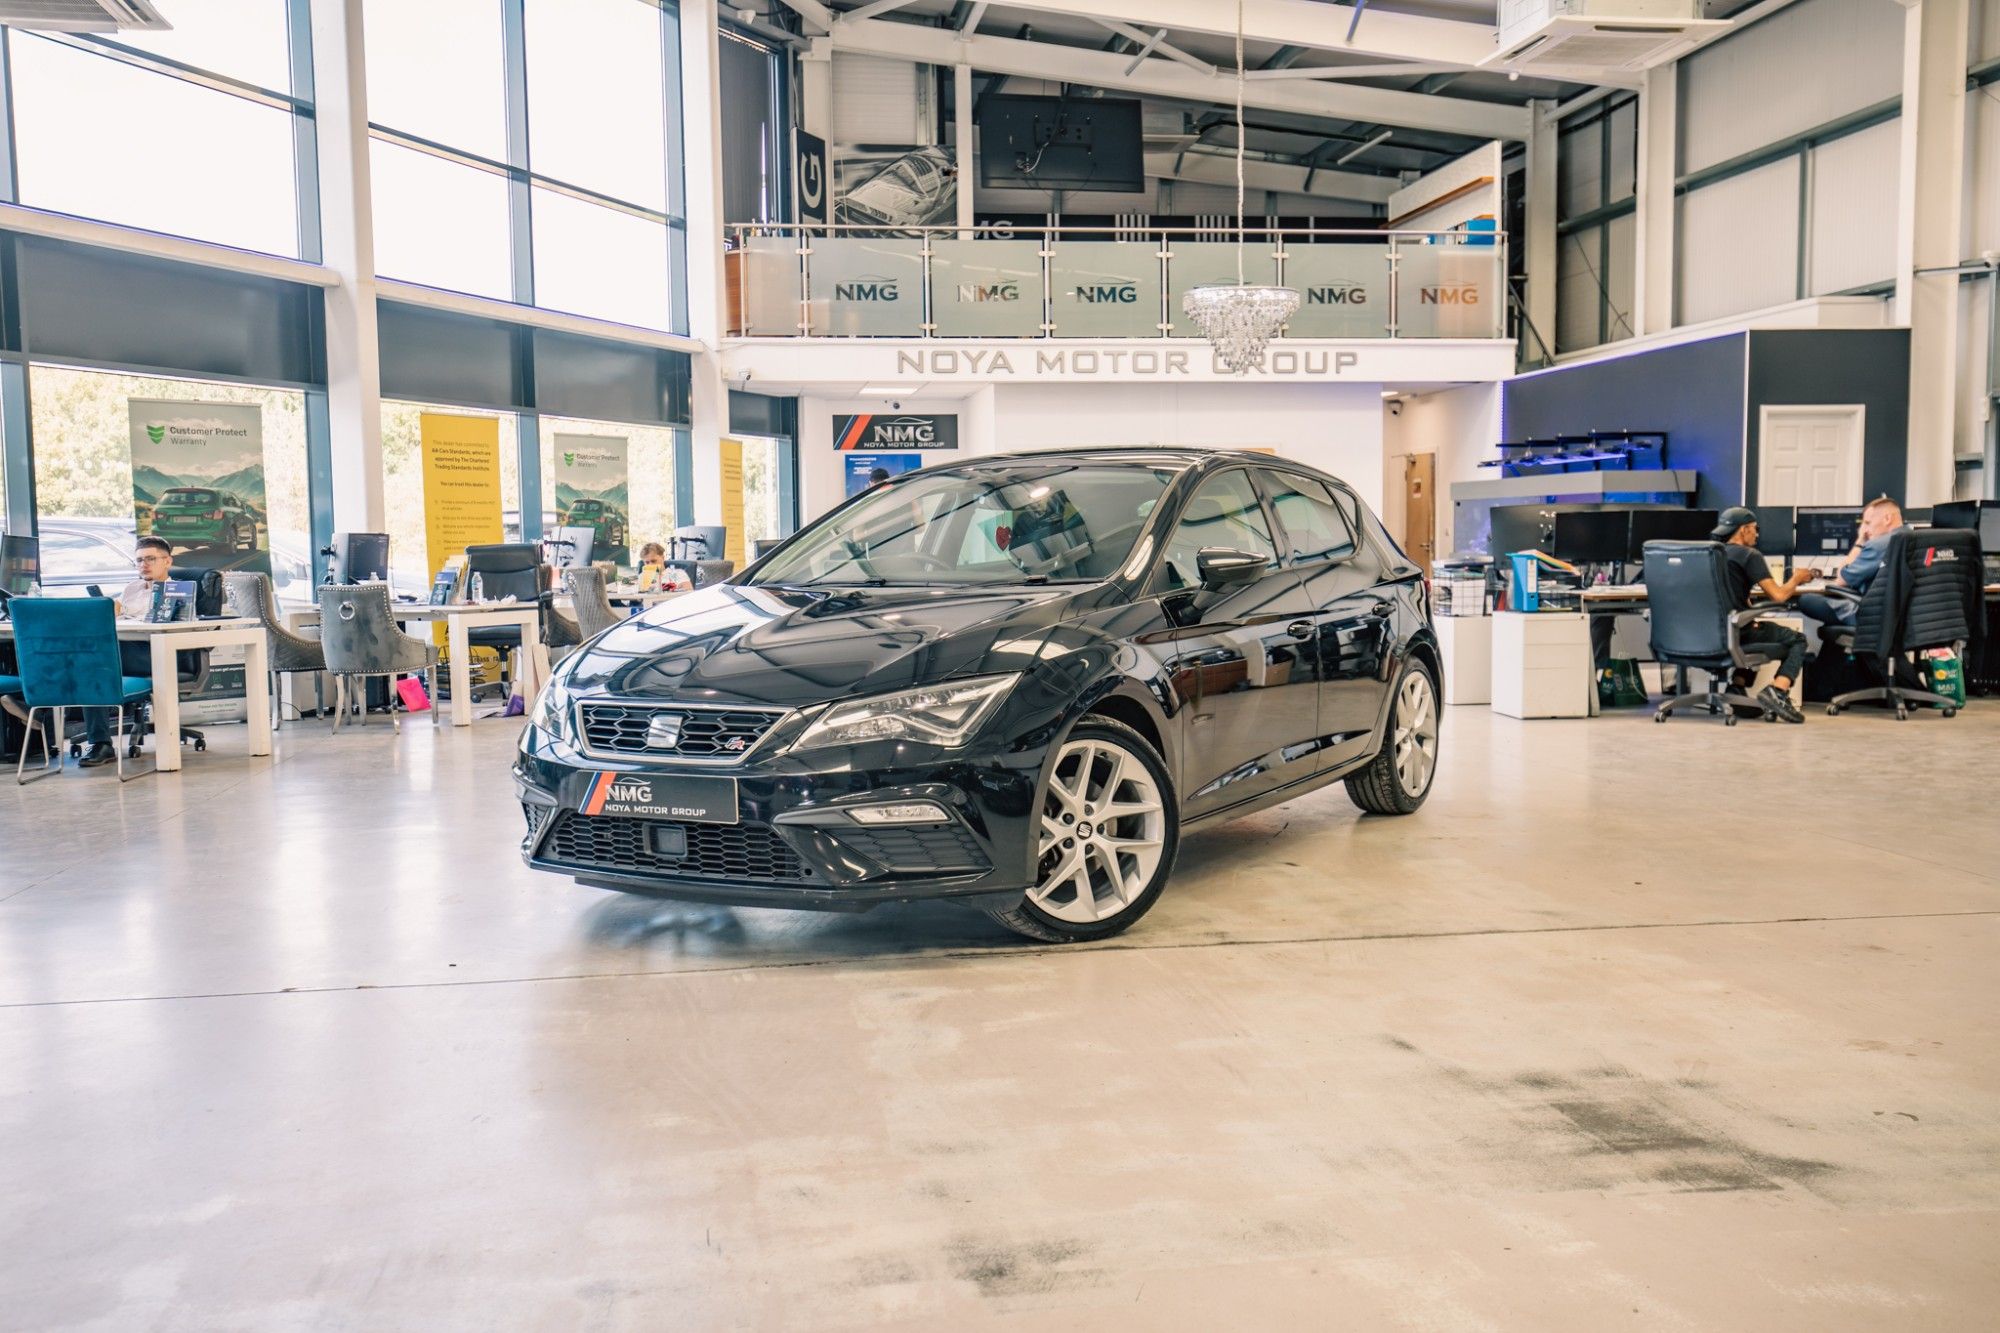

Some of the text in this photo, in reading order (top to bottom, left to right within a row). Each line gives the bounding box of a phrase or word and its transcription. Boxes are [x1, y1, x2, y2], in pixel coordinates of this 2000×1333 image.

[835, 284, 899, 302] NMG
[956, 284, 1020, 302] NMG
[1076, 286, 1138, 303] NMG
[1307, 287, 1367, 304] NMG
[1420, 287, 1479, 305] NMG
[897, 350, 1014, 374] NOYA
[1036, 350, 1189, 374] MOTOR
[169, 426, 248, 437] Customer Protect
[873, 425, 935, 442] NMG
[170, 437, 207, 446] Warranty
[605, 784, 653, 803] NMG
[604, 804, 706, 817] NOYA MOTOR GROUP
